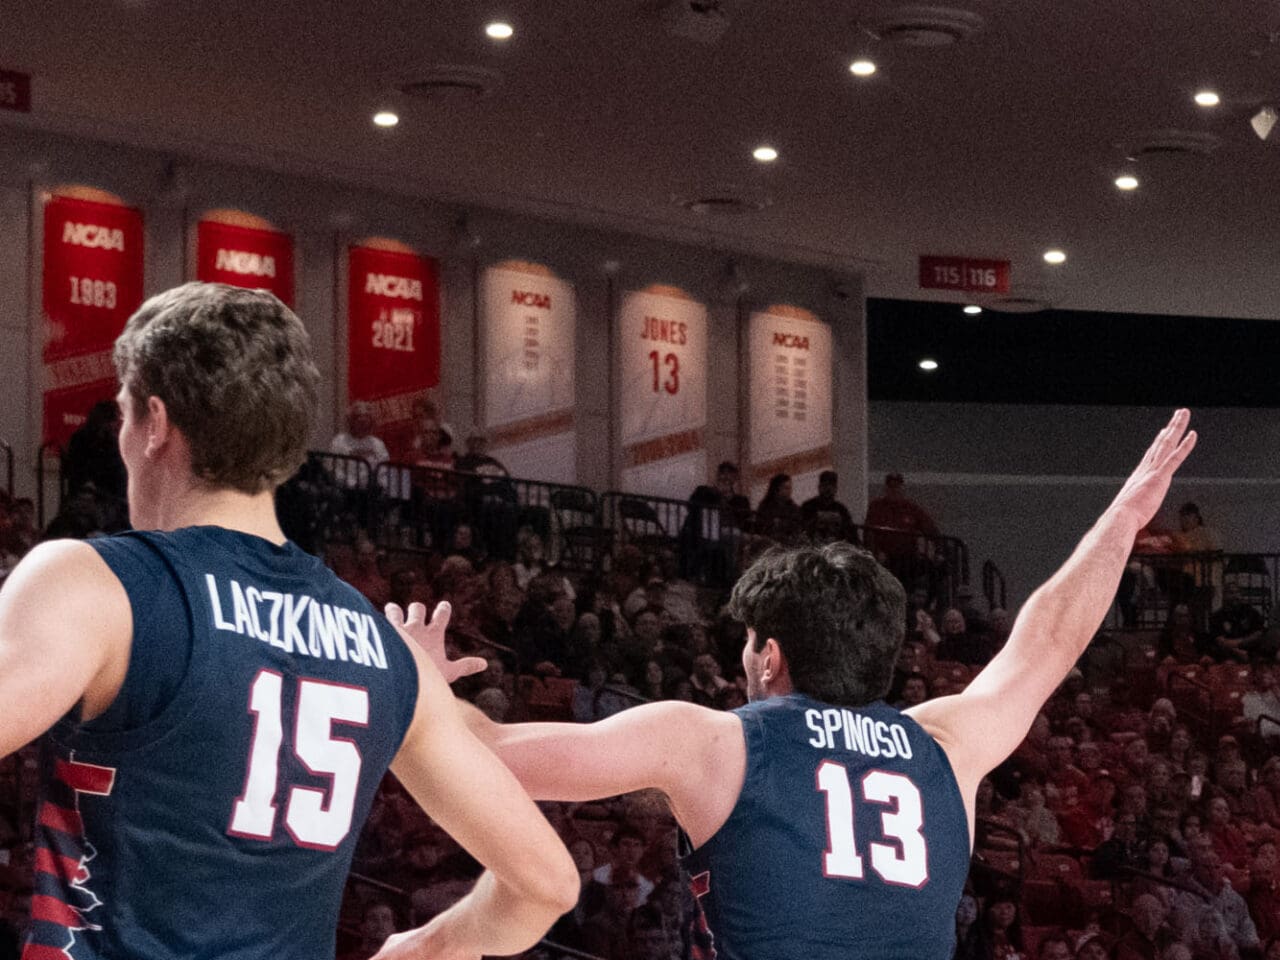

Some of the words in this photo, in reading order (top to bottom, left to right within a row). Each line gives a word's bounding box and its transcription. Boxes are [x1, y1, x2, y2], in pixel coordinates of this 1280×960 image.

[62, 221, 124, 252] NCAA
[215, 248, 276, 278] NCAA
[933, 265, 961, 285] 115
[970, 267, 997, 287] 116
[365, 273, 423, 301] NCAA
[511, 290, 551, 310] NCAA
[640, 316, 688, 346] JONES
[772, 333, 809, 351] NCAA
[648, 350, 680, 396] 13
[205, 573, 388, 670] LACZKOWSKI
[805, 708, 913, 760] SPINOSO
[227, 667, 370, 852] 15
[816, 758, 930, 890] 13
